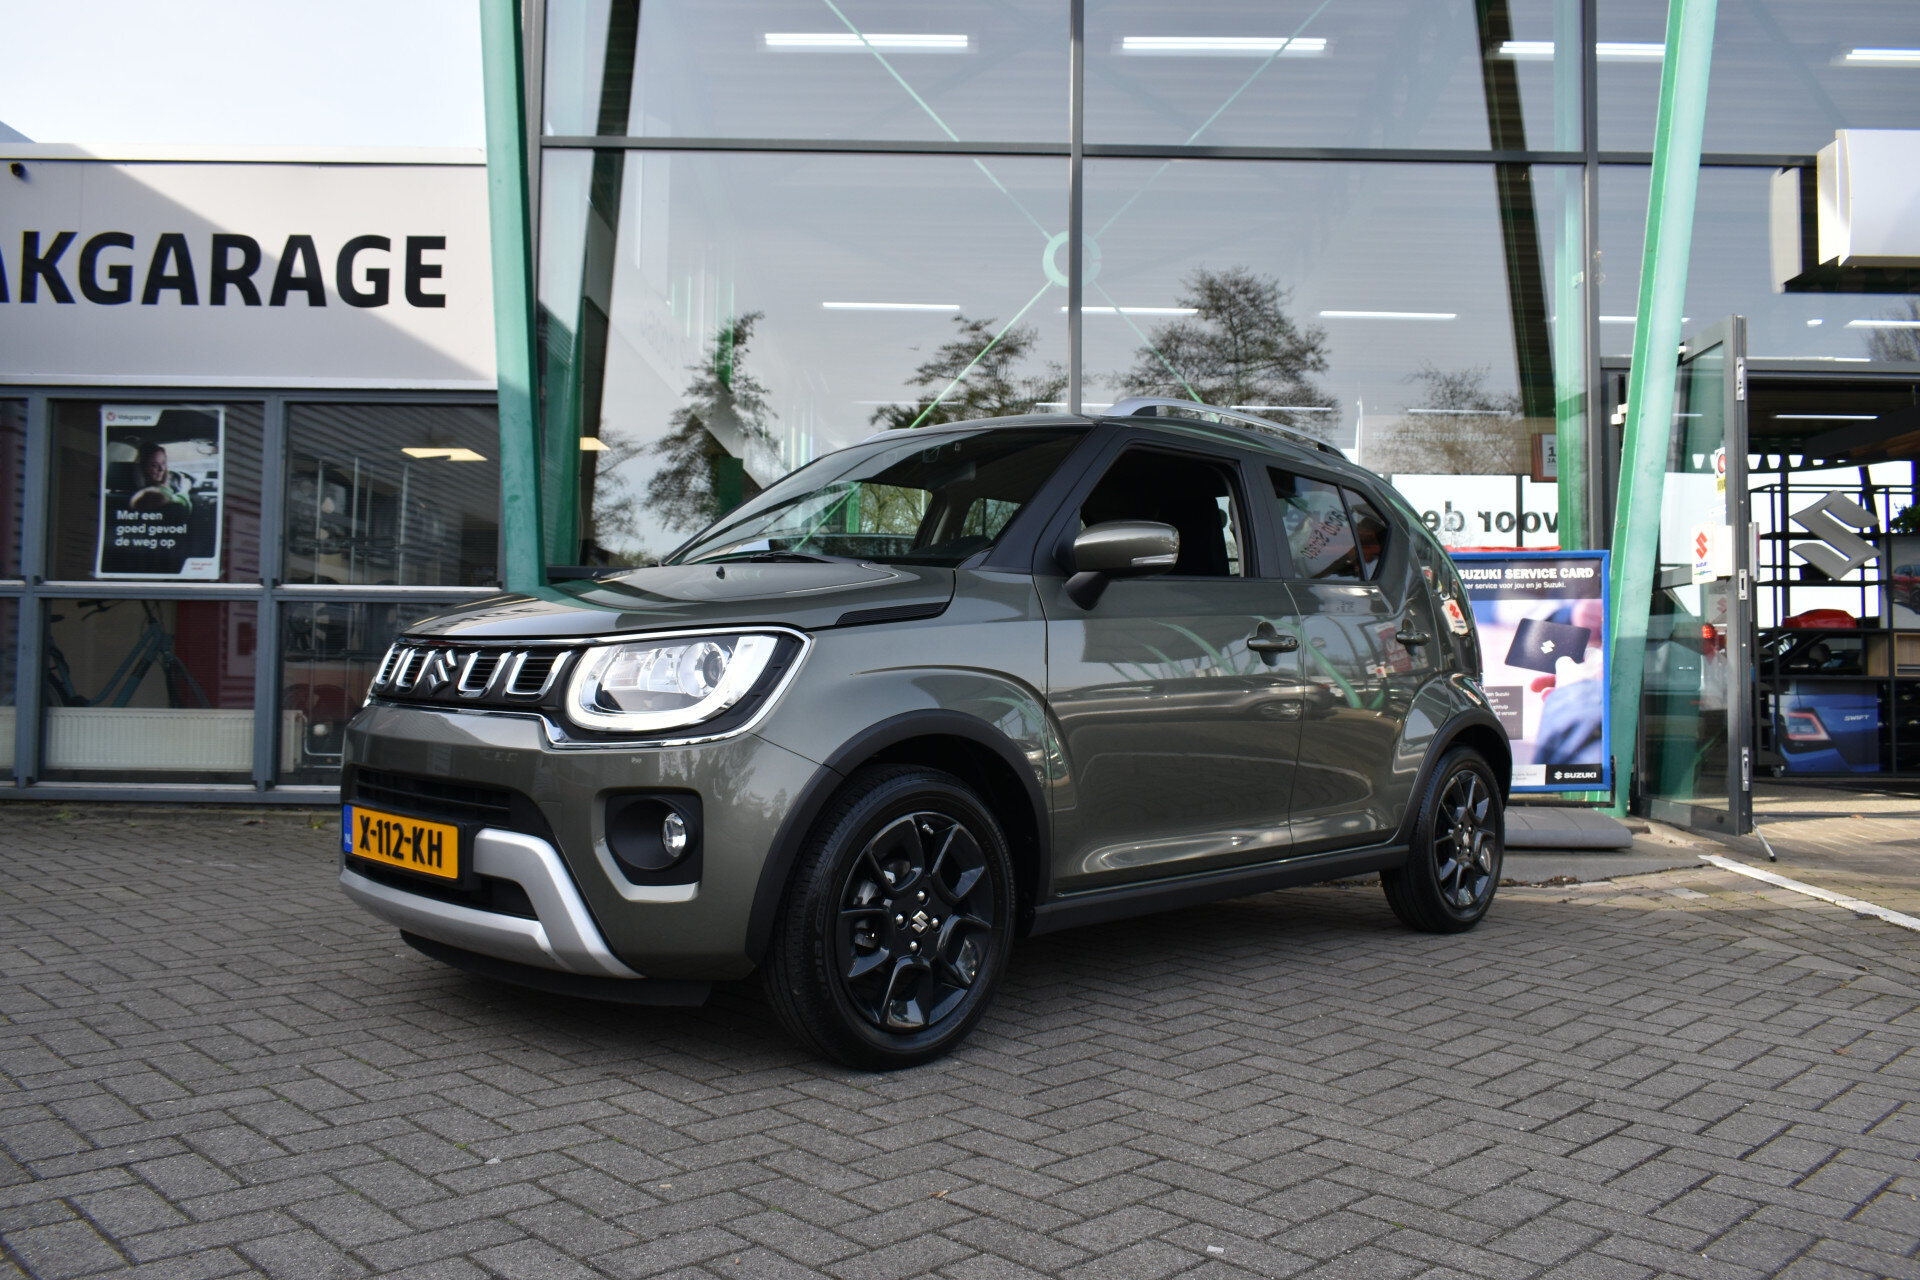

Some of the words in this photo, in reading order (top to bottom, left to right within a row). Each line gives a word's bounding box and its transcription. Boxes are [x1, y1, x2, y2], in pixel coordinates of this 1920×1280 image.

[0, 230, 447, 309] KGARAGE
[117, 510, 139, 520] Met
[141, 512, 163, 520] een
[116, 524, 146, 535] goed
[148, 524, 187, 536] gevoel
[115, 537, 130, 546] de
[133, 539, 157, 549] weg
[160, 539, 176, 549] op
[1459, 569, 1502, 580] SUZUKI
[1504, 568, 1558, 579] SERVICE
[1560, 567, 1595, 579] CARD
[1514, 582, 1525, 590] jou
[1844, 714, 1870, 722] SWIFT
[1563, 771, 1597, 779] SUZUKI
[359, 814, 443, 869] X-112-KH
